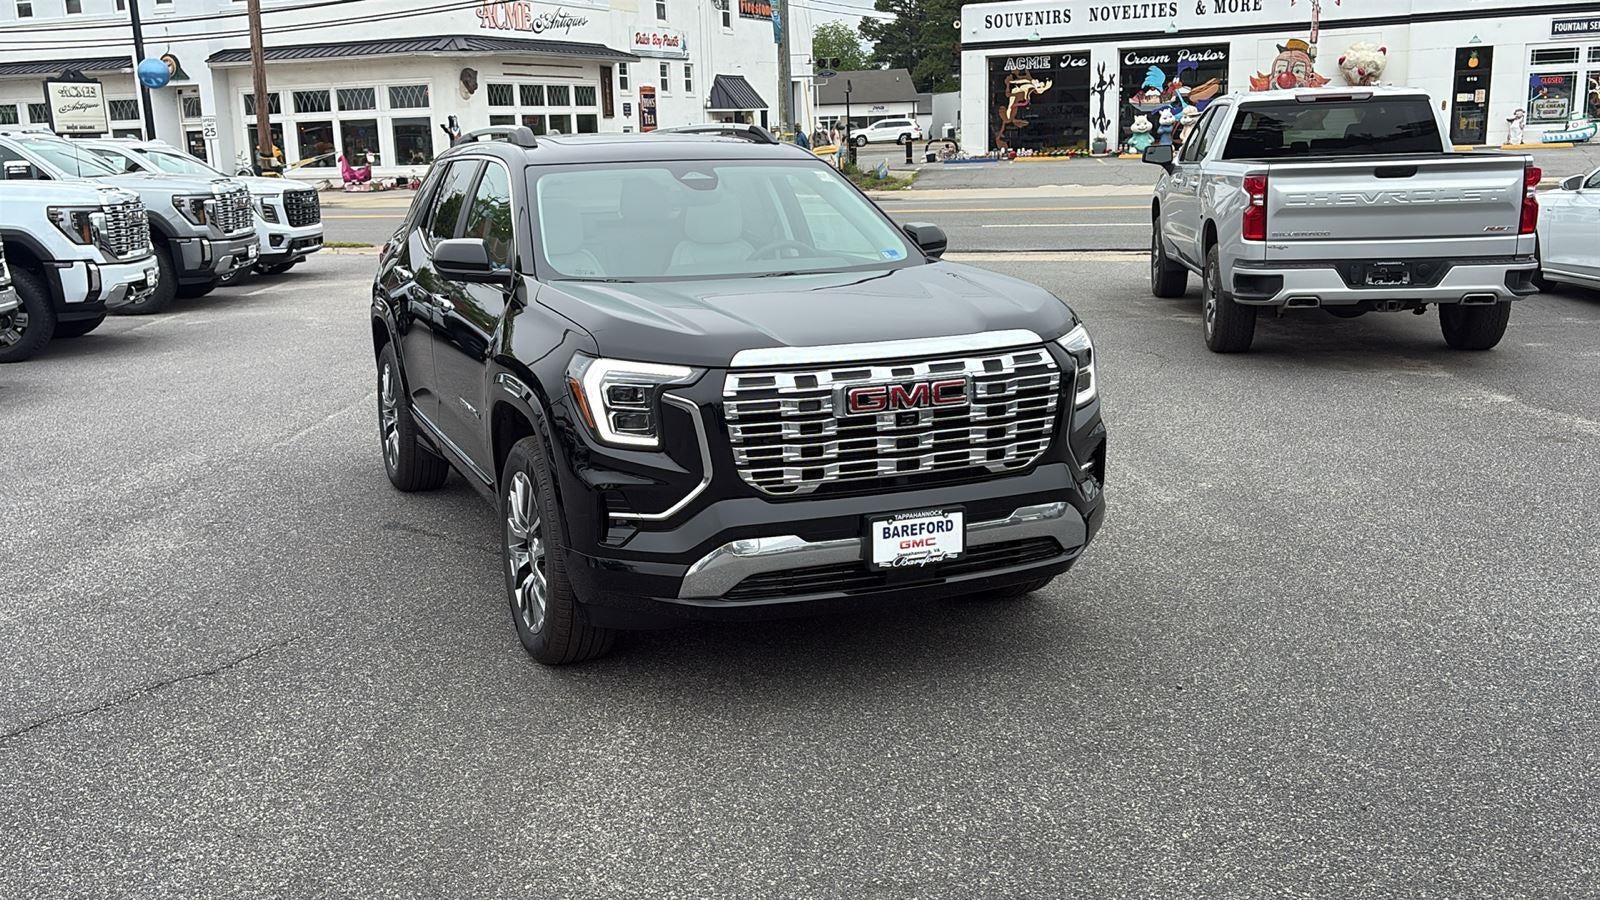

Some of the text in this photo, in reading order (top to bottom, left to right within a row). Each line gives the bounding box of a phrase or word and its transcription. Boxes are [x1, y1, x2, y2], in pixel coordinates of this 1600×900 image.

[476, 0, 588, 34] ACME Antiques
[984, 0, 1262, 30] SOUVENIRS NOVELTIES & MORE
[1554, 22, 1589, 32] FOUNTAIN
[652, 33, 662, 48] Boy
[663, 34, 679, 47] Paints
[1004, 54, 1088, 71] ACME Ice
[1124, 48, 1226, 66] Cream Parlor
[1541, 76, 1564, 84] CLOSED
[643, 113, 655, 125] TEA
[204, 127, 216, 137] 25
[1285, 188, 1507, 206] CHEVROLET
[848, 378, 968, 413] GMC
[894, 509, 944, 520] TAPPAHANNOCK
[882, 519, 954, 540] BAREFORD
[899, 537, 937, 549] GMC
[892, 550, 946, 567] Bareford
